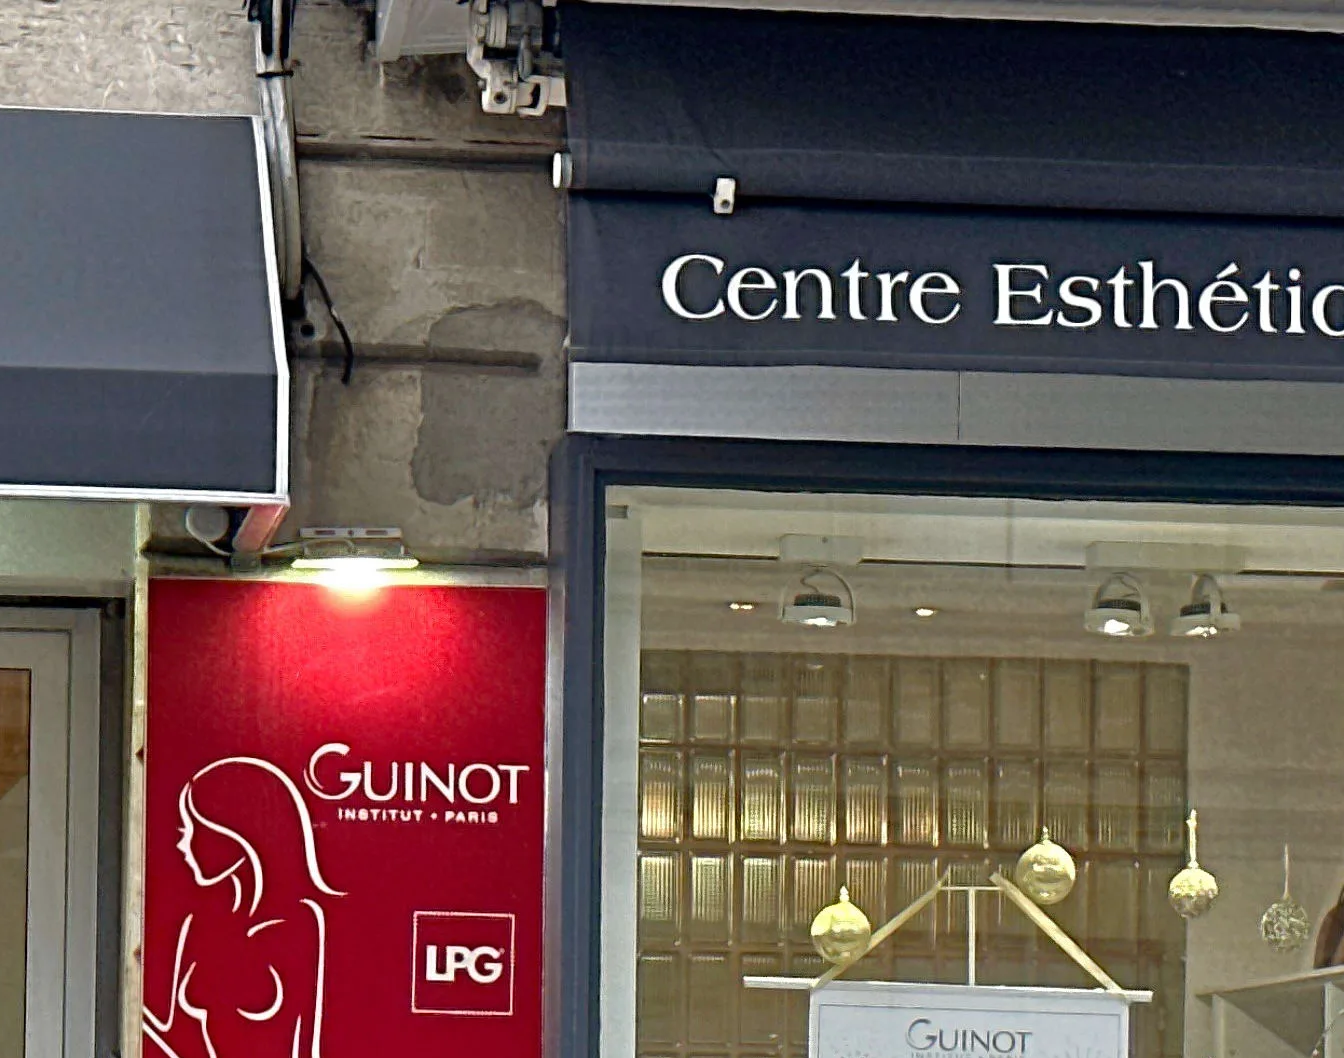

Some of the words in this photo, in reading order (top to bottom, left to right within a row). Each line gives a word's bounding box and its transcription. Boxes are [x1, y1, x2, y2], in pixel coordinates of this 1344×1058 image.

[661, 253, 962, 325] Centre
[303, 743, 531, 804] GUINOT
[338, 807, 423, 823] INSTITUT
[444, 810, 499, 824] PARIS
[906, 1018, 1033, 1054] GUINOT
